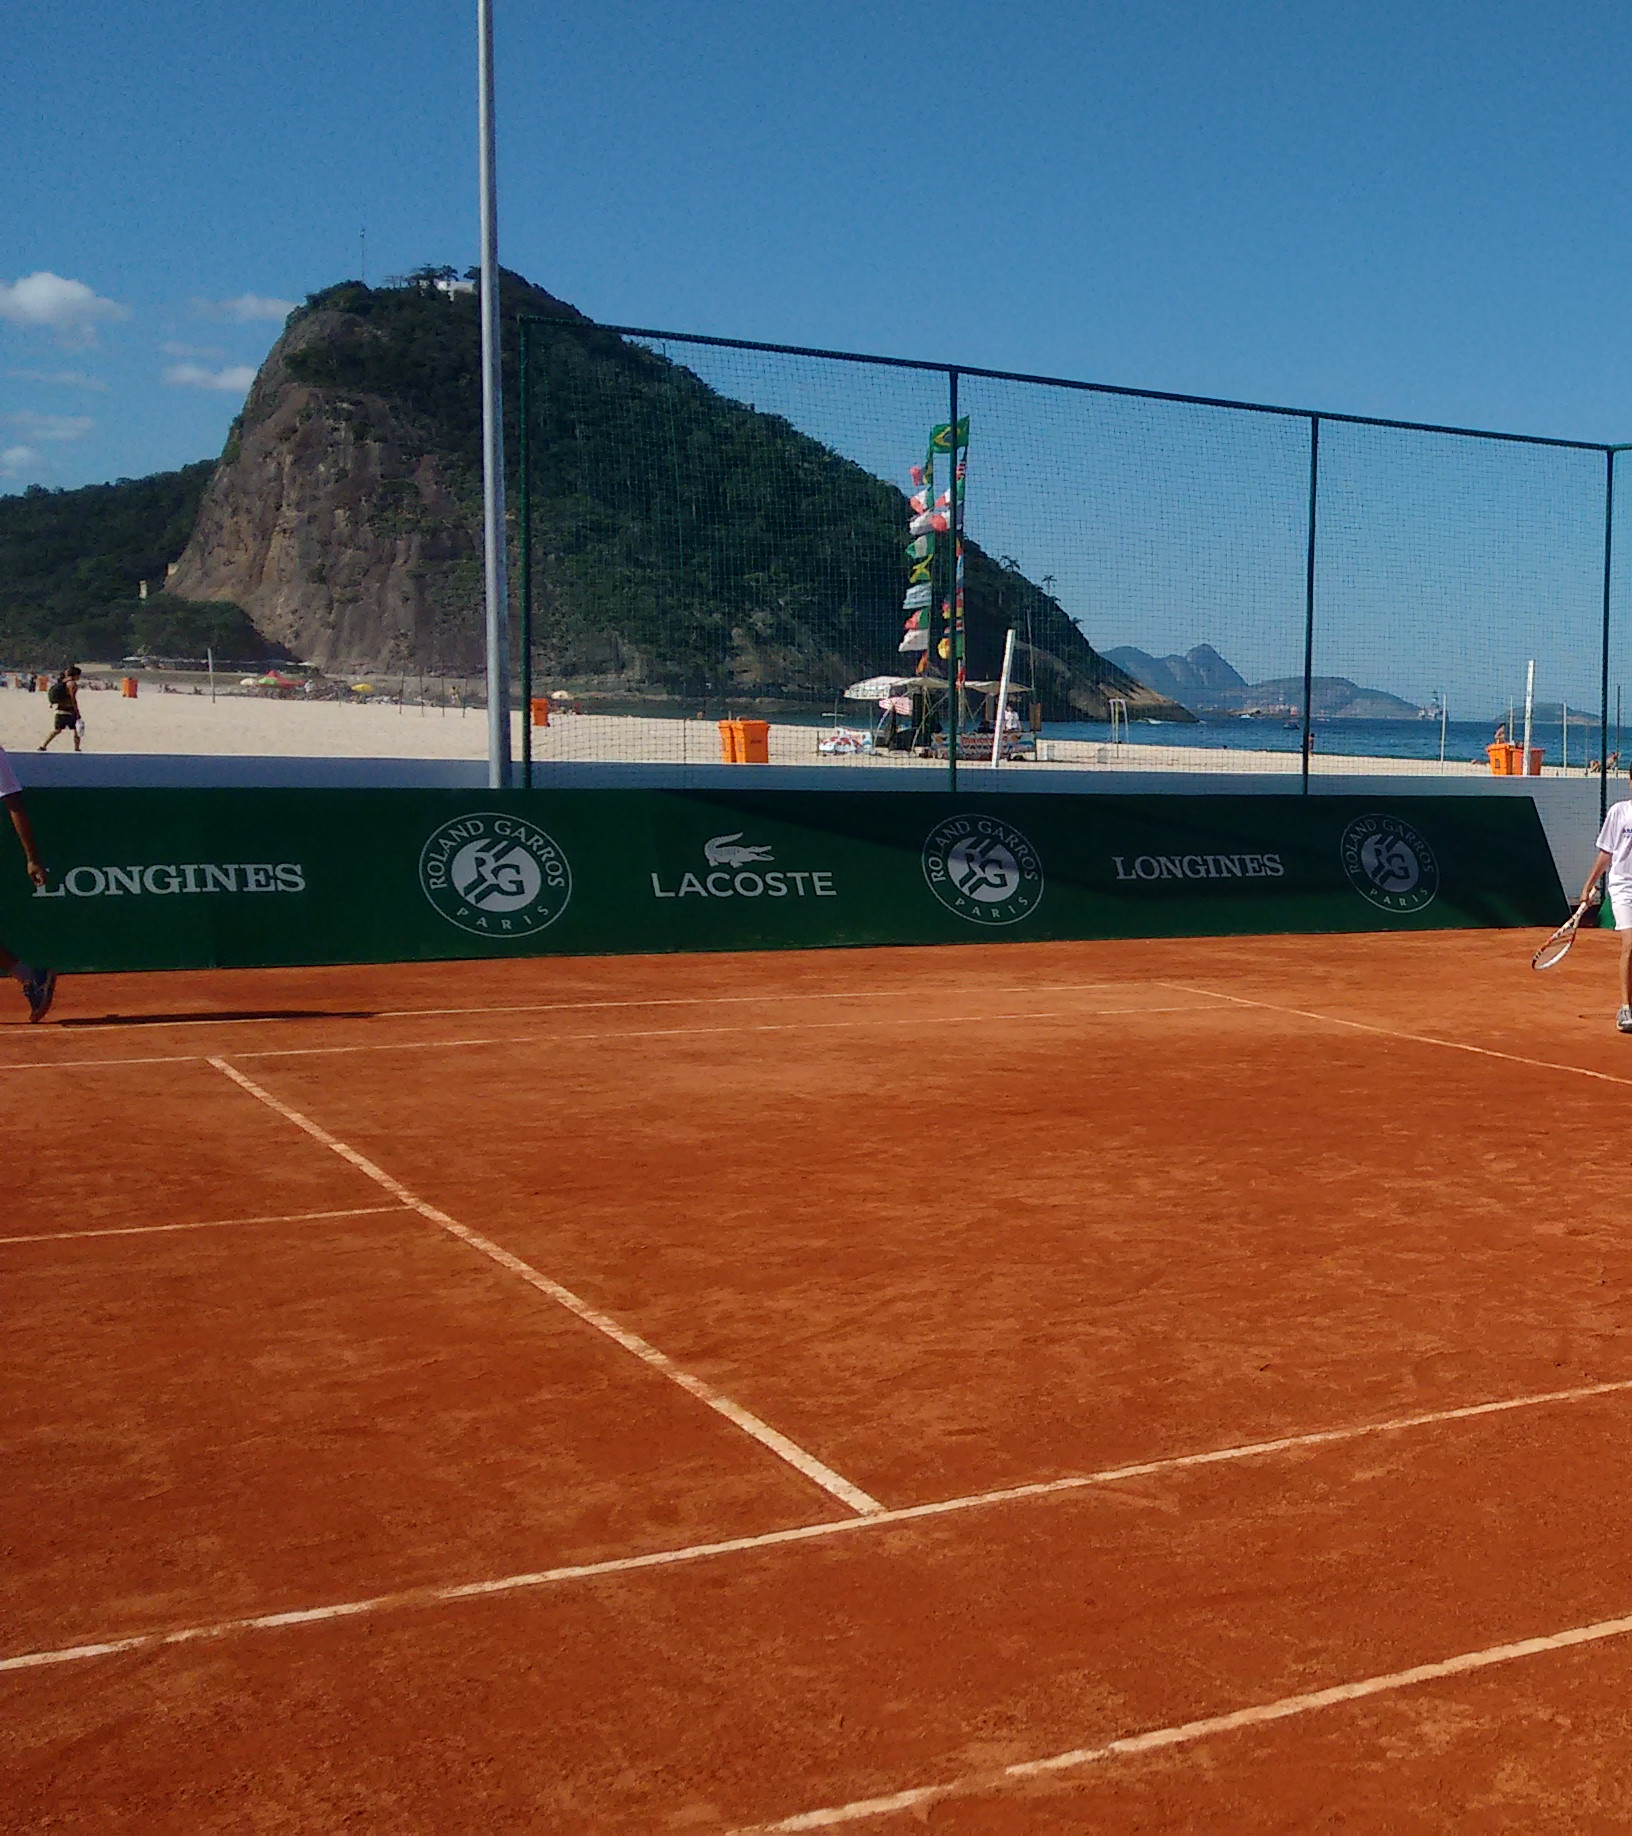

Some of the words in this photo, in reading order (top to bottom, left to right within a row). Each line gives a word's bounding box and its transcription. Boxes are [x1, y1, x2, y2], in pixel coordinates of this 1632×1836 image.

[427, 820, 484, 889] ROLAND
[494, 820, 565, 887] GARROS
[928, 821, 970, 883] ROLAND
[978, 821, 1038, 880] GARROS
[1346, 820, 1377, 874] ROLAND
[1383, 820, 1434, 872] GARROS
[1112, 854, 1284, 880] LONGINES
[651, 872, 837, 897] LACOSTE
[955, 897, 1028, 918] PARIS
[1370, 888, 1428, 907] PARIS
[457, 905, 549, 930] PARIS
